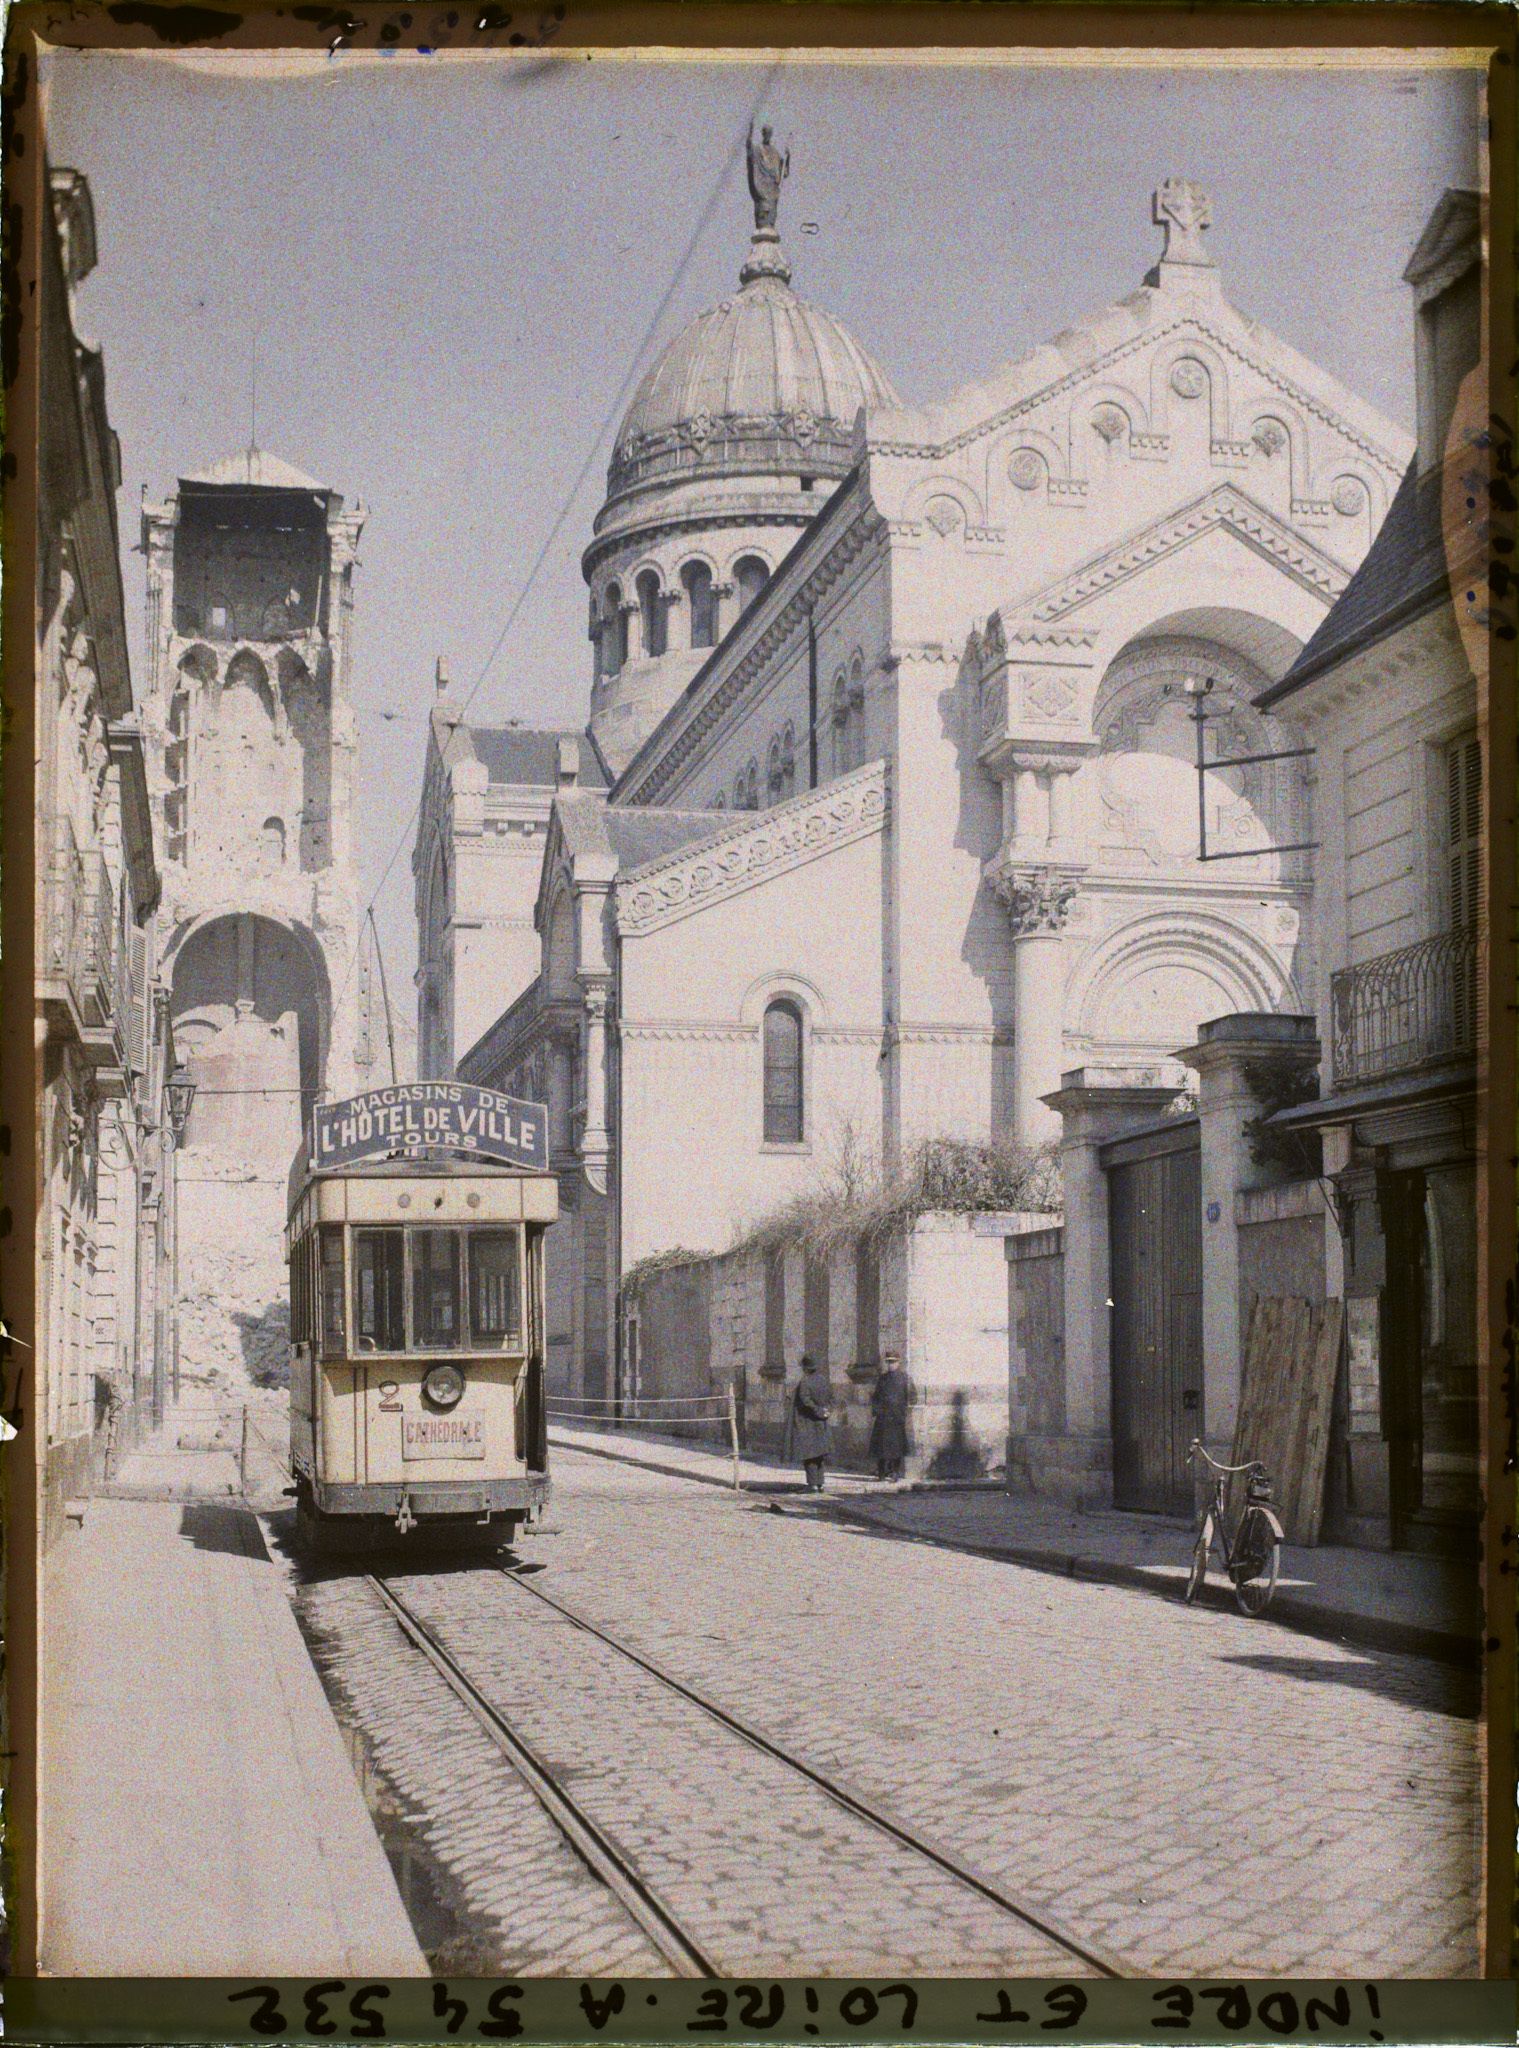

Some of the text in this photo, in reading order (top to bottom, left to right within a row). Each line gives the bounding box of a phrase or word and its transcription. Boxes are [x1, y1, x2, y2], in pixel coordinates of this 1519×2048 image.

[349, 1085, 462, 1115] MAGASINS
[478, 1092, 509, 1114] DE
[386, 1131, 477, 1147] TOURS
[423, 1107, 450, 1130] DE
[458, 1105, 535, 1150] VILLE
[378, 1380, 403, 1412] 2
